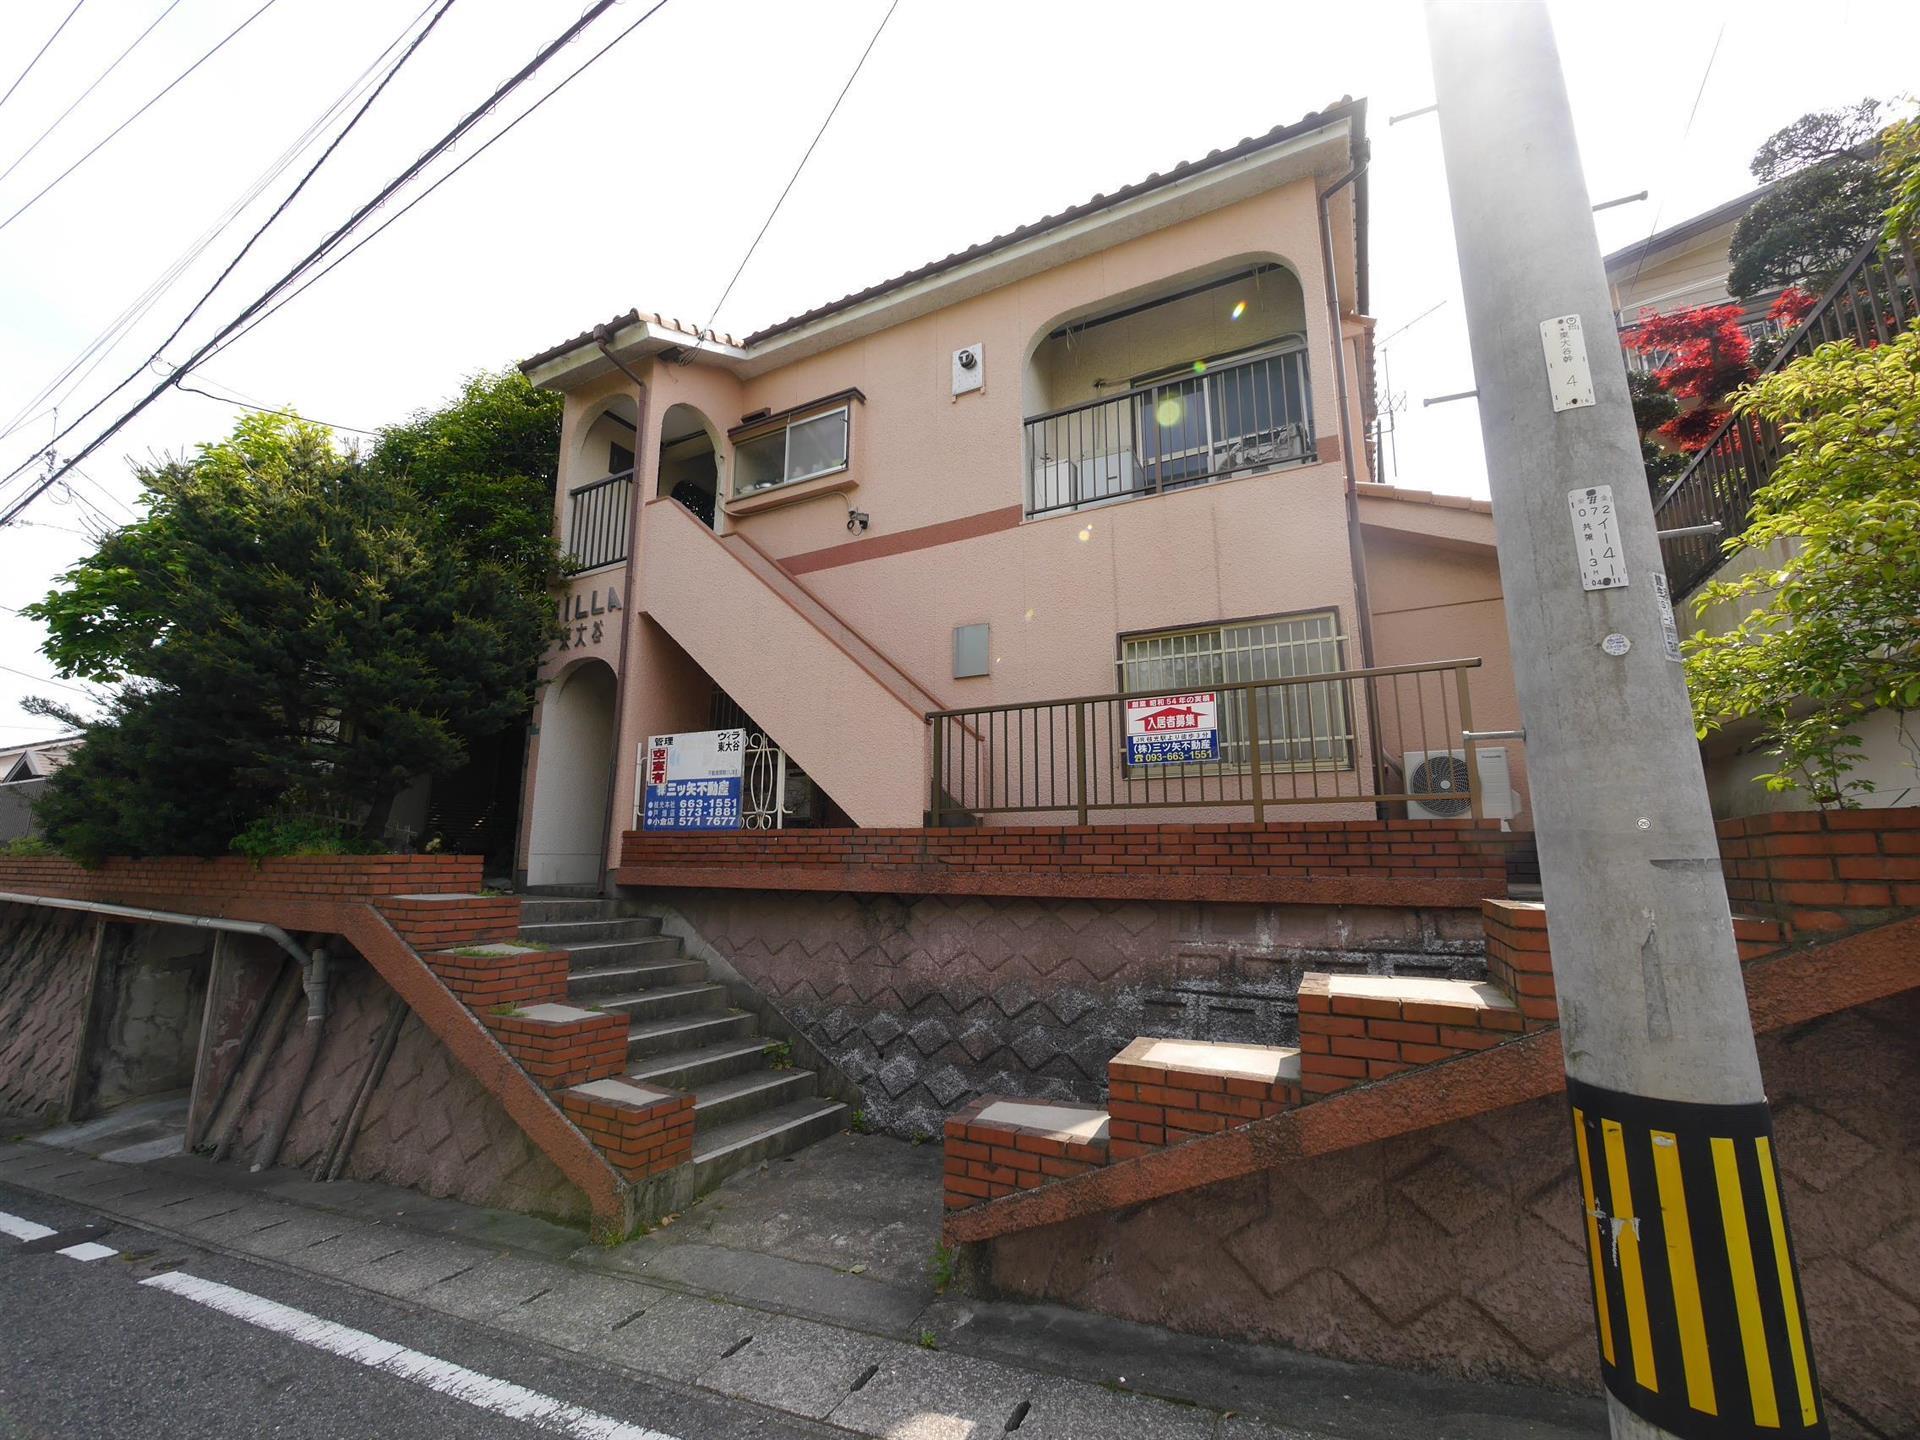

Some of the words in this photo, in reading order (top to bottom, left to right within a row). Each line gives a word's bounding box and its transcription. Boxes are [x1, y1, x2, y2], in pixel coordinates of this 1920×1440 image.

[1566, 374, 1578, 387] 4
[1578, 505, 1610, 517] 072
[1147, 714, 1196, 730] 入居者募集
[654, 736, 674, 747] 管理
[717, 731, 741, 741] ヴィラ
[717, 741, 740, 752] 東大谷
[1133, 739, 1212, 754] (株)三ツ矢不動産
[1145, 750, 1213, 762] 093-663-1551
[652, 749, 666, 784] 空室有
[679, 798, 737, 808] 663-1551
[678, 807, 737, 817] 873-1881
[652, 817, 675, 826] 小倉店
